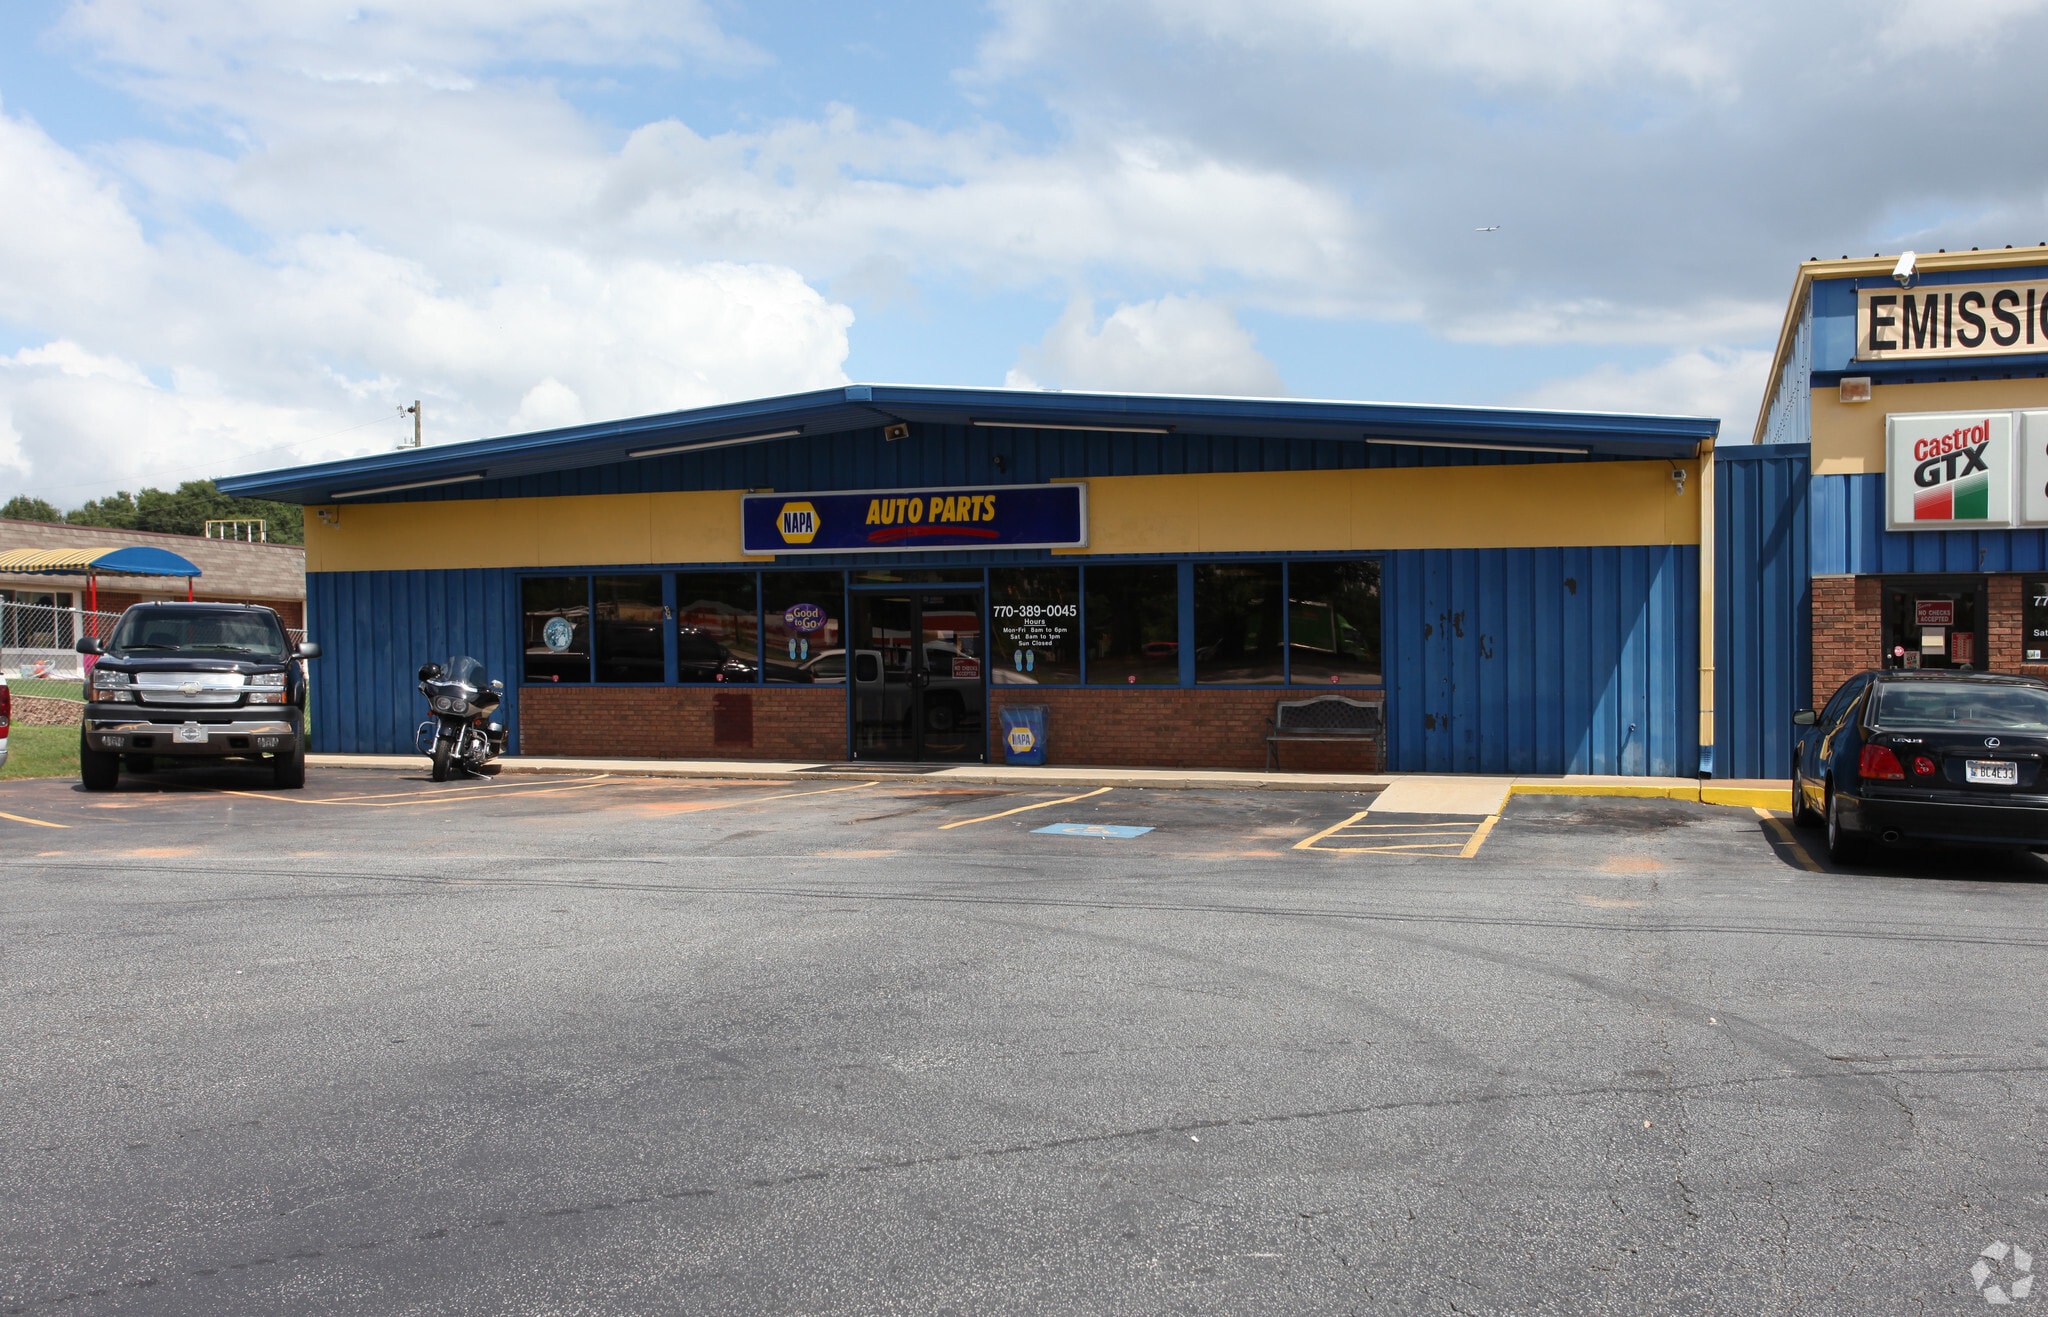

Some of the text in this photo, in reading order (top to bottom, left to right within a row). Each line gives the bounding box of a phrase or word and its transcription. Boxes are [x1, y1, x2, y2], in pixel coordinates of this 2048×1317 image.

[1869, 288, 2048, 351] EMISSI
[1914, 418, 1990, 461] Castrol
[1913, 442, 1989, 487] GTX
[783, 495, 996, 534] NAPA AUTO PARTS
[793, 607, 819, 618] Good
[802, 617, 817, 629] Go
[993, 605, 1077, 617] 770-389-0045
